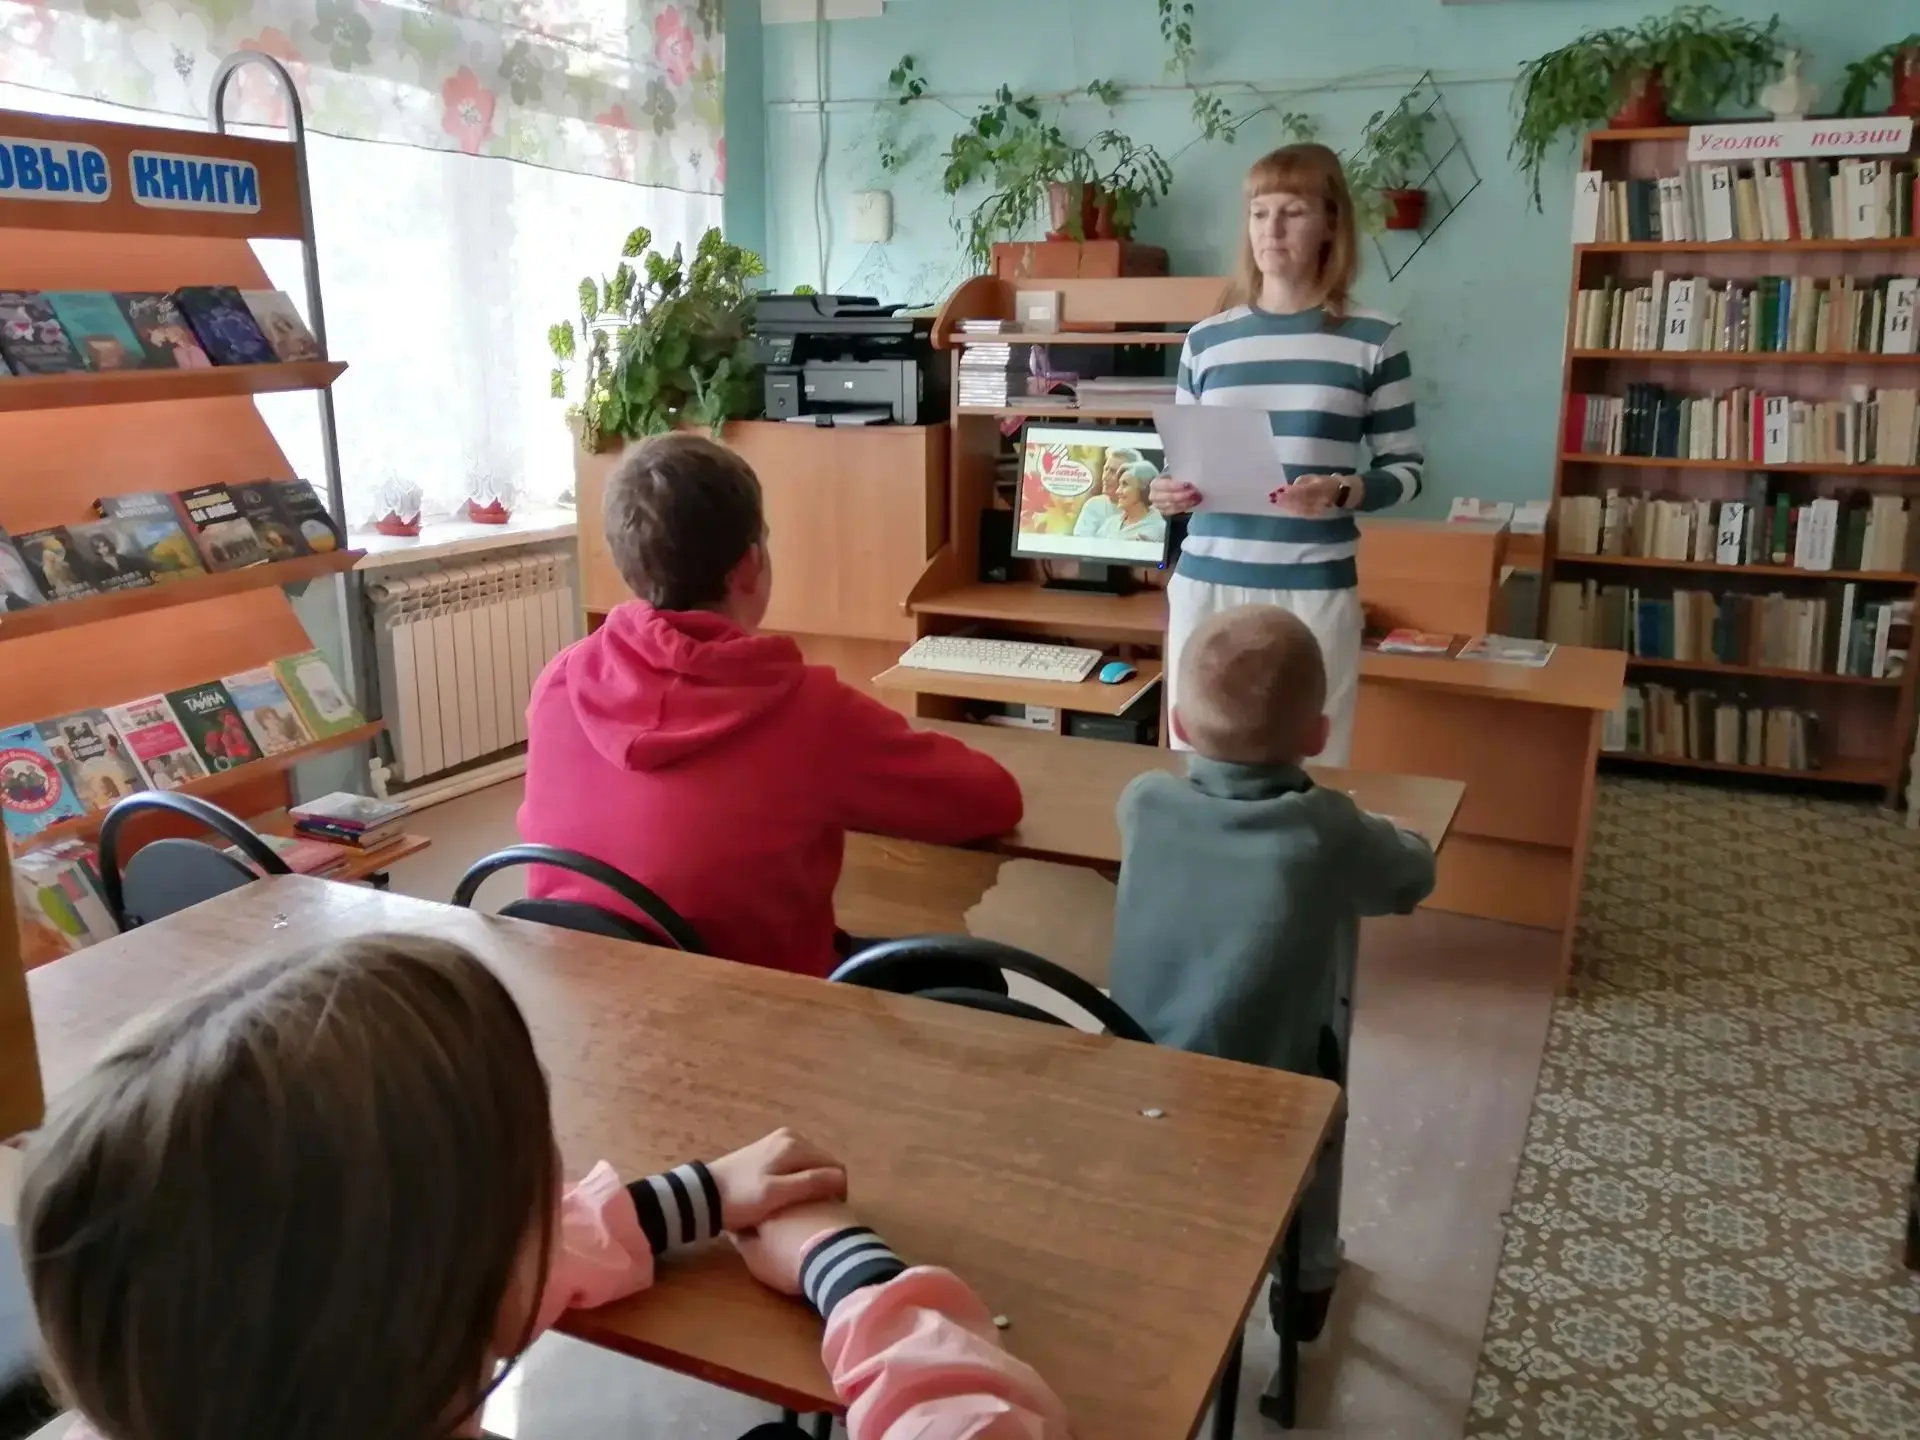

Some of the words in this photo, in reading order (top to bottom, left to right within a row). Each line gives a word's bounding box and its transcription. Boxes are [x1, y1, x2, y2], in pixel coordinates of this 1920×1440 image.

[1695, 132, 1785, 152] Уголок
[1811, 125, 1903, 147] поэзии
[133, 154, 259, 207] книги
[1711, 172, 1727, 192] Б
[1858, 167, 1875, 186] В
[1583, 180, 1599, 193] А
[1674, 286, 1692, 305] Д
[1670, 318, 1686, 335] И
